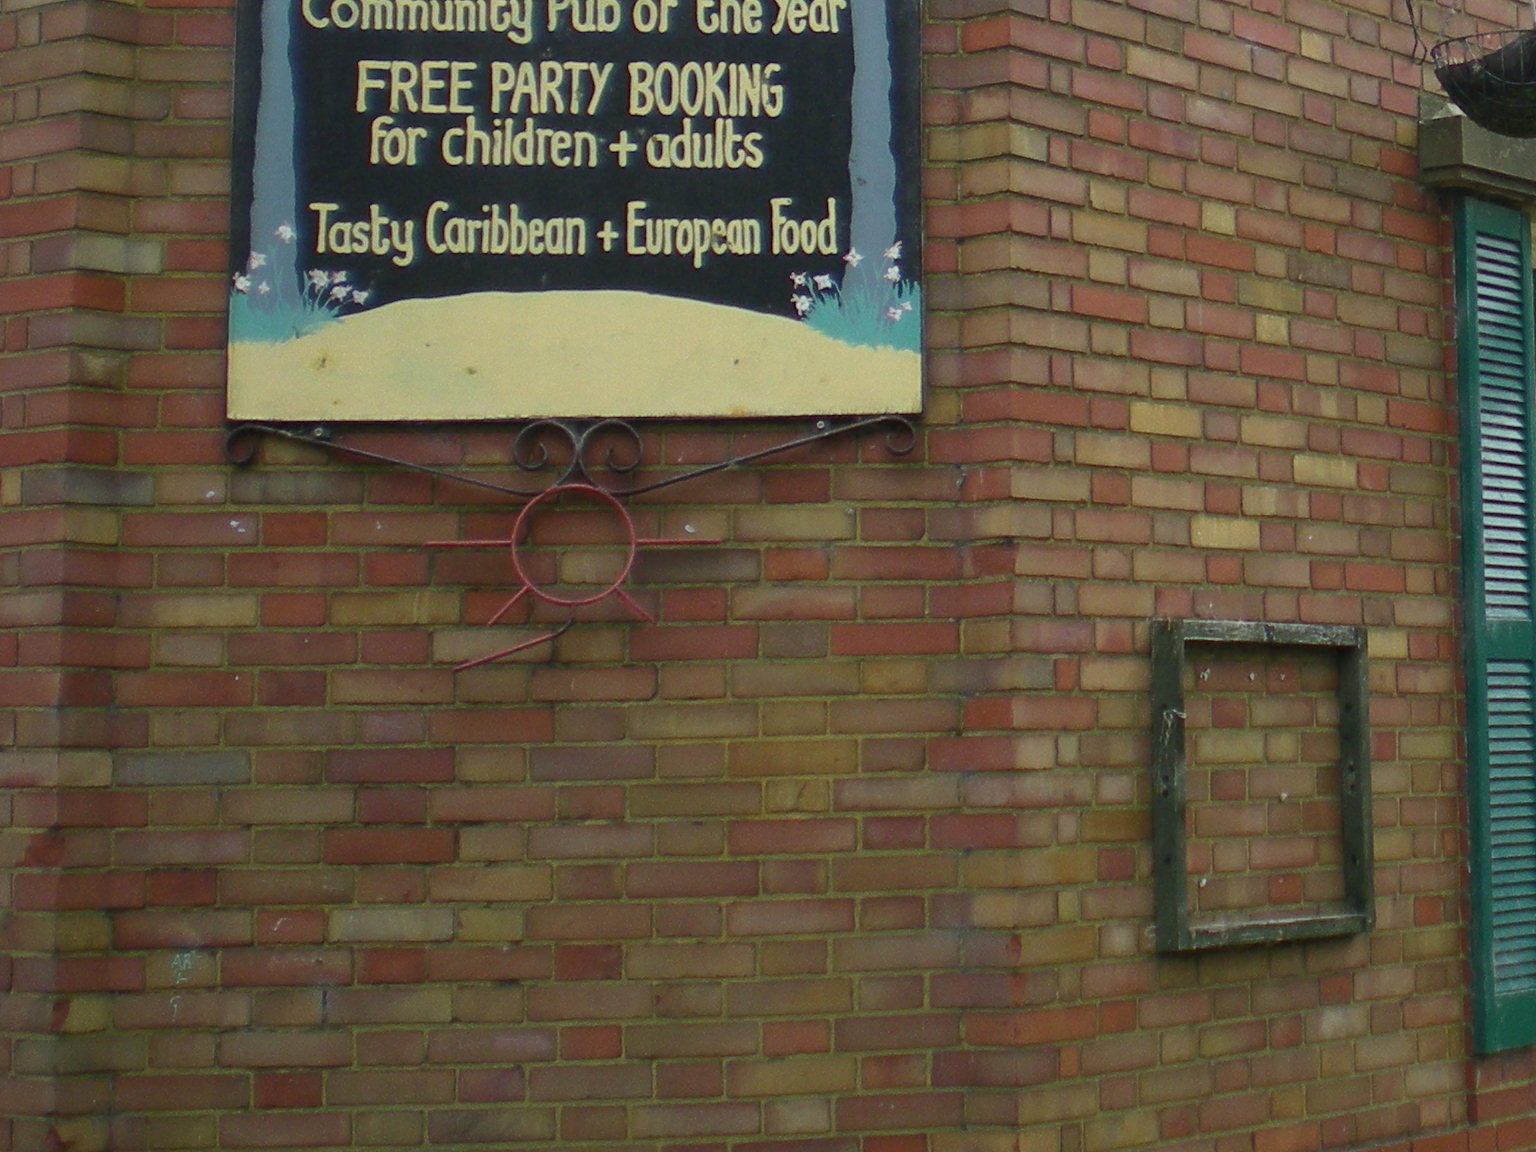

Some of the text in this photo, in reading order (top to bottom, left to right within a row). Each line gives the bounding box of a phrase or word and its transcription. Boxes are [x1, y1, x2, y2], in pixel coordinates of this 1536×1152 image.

[356, 60, 783, 119] FREE PARTY BOOKING
[370, 116, 764, 169] for children + adults
[310, 197, 838, 268] Tasty Caribbean + European Food
